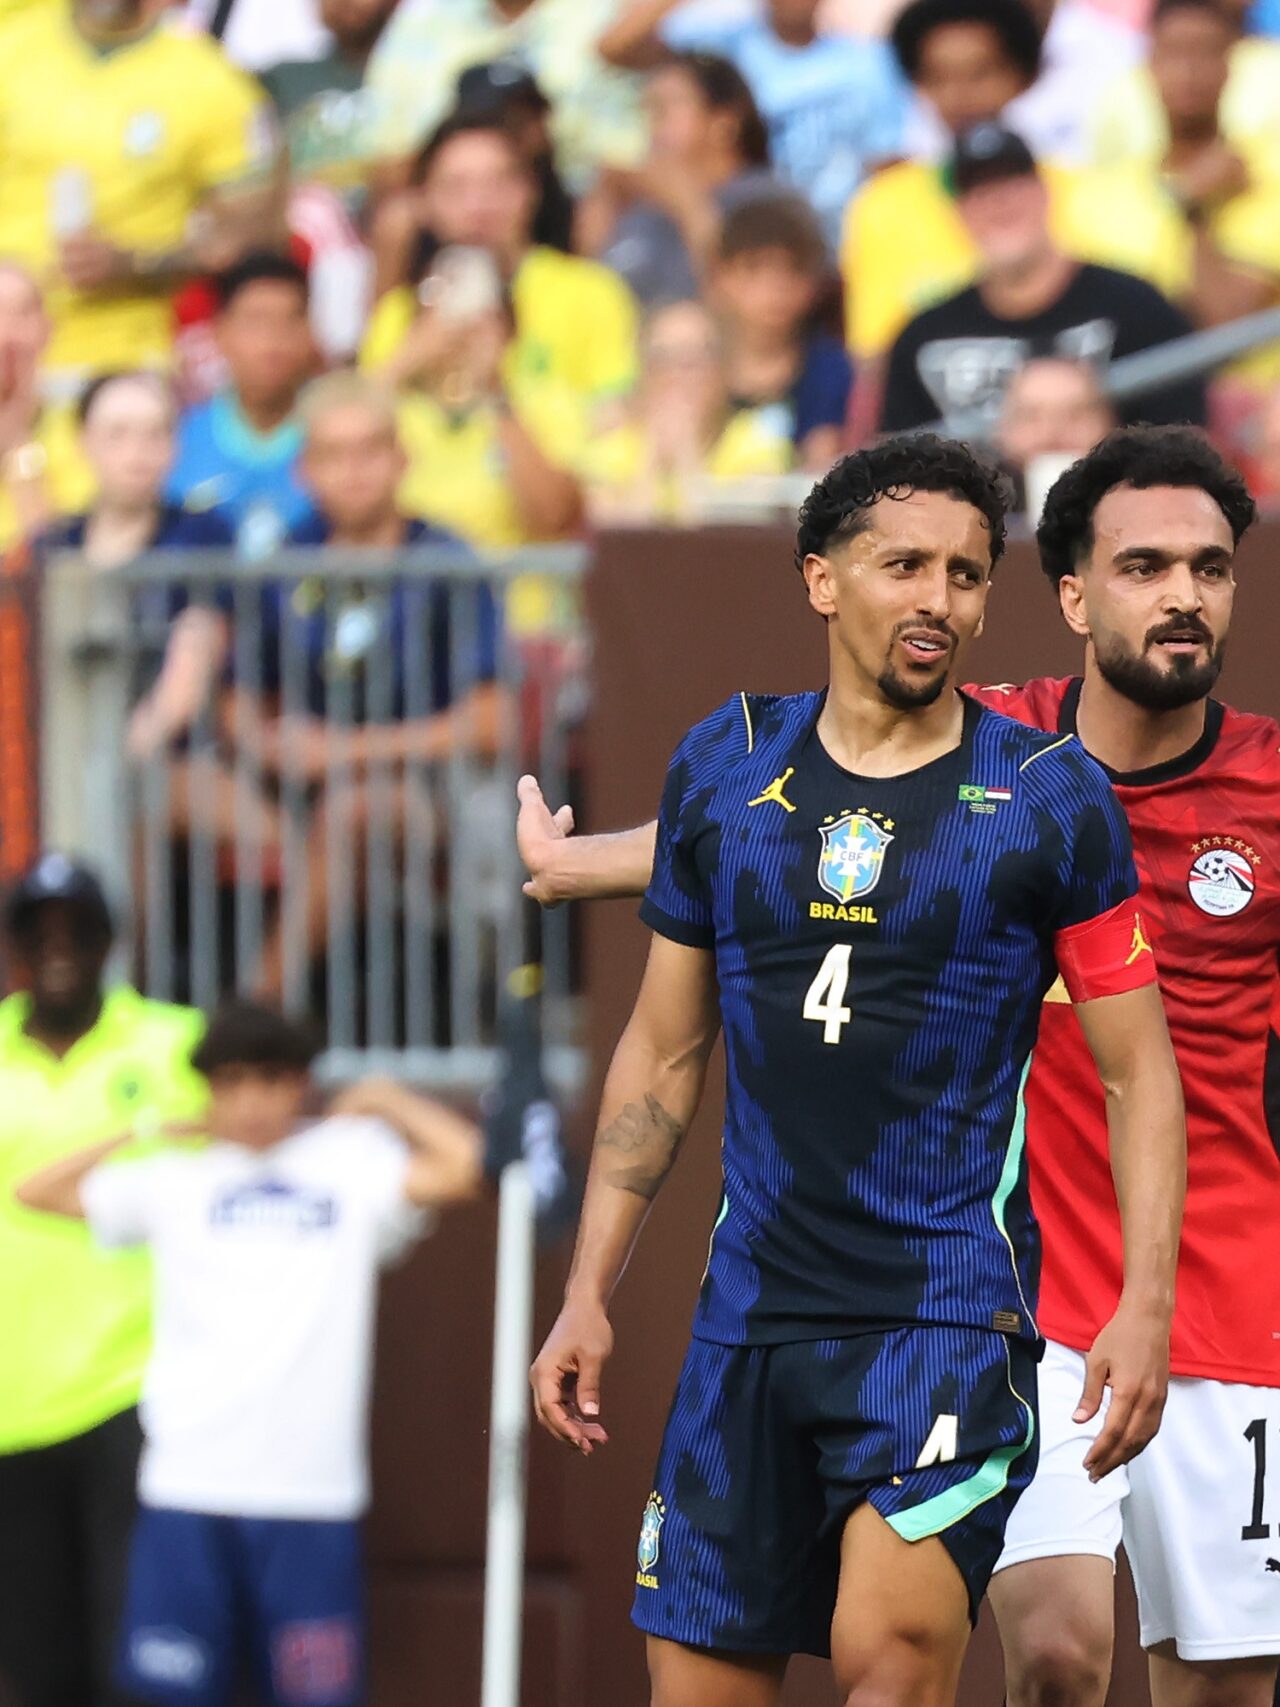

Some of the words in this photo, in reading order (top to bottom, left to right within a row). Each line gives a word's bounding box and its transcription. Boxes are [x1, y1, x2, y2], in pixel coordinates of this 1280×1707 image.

[840, 851, 864, 862] CBF
[809, 902, 878, 923] BRASIL
[803, 943, 853, 1044] 4
[636, 1571, 659, 1589] RASIL
